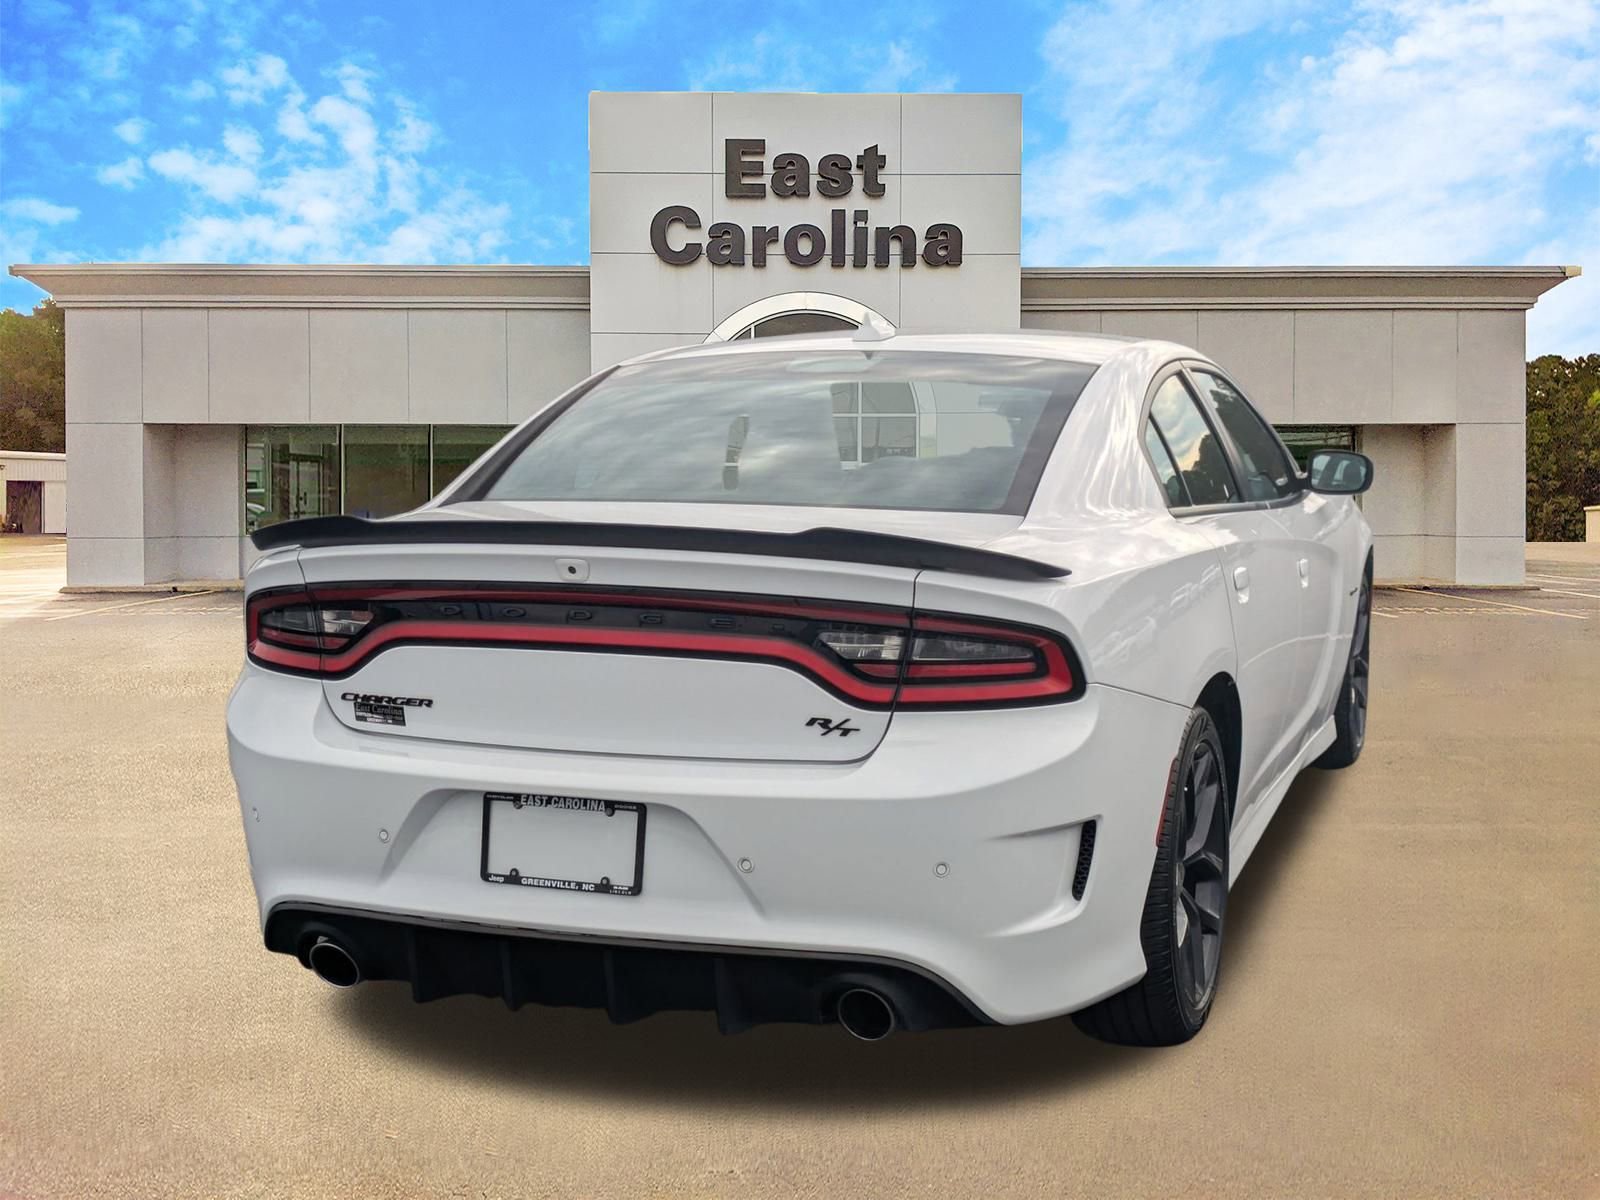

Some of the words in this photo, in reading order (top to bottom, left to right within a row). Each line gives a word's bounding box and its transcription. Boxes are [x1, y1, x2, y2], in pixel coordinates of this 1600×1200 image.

[725, 138, 886, 199] East
[650, 205, 963, 268] Carolina
[439, 604, 737, 629] DODGE
[341, 692, 433, 708] CHARGER
[805, 717, 861, 737] R/T
[520, 794, 548, 807] EAST
[551, 798, 606, 812] CAROLINA
[488, 874, 505, 884] Jeep
[521, 877, 579, 890] GREENVILLE,
[582, 884, 595, 892] NC
